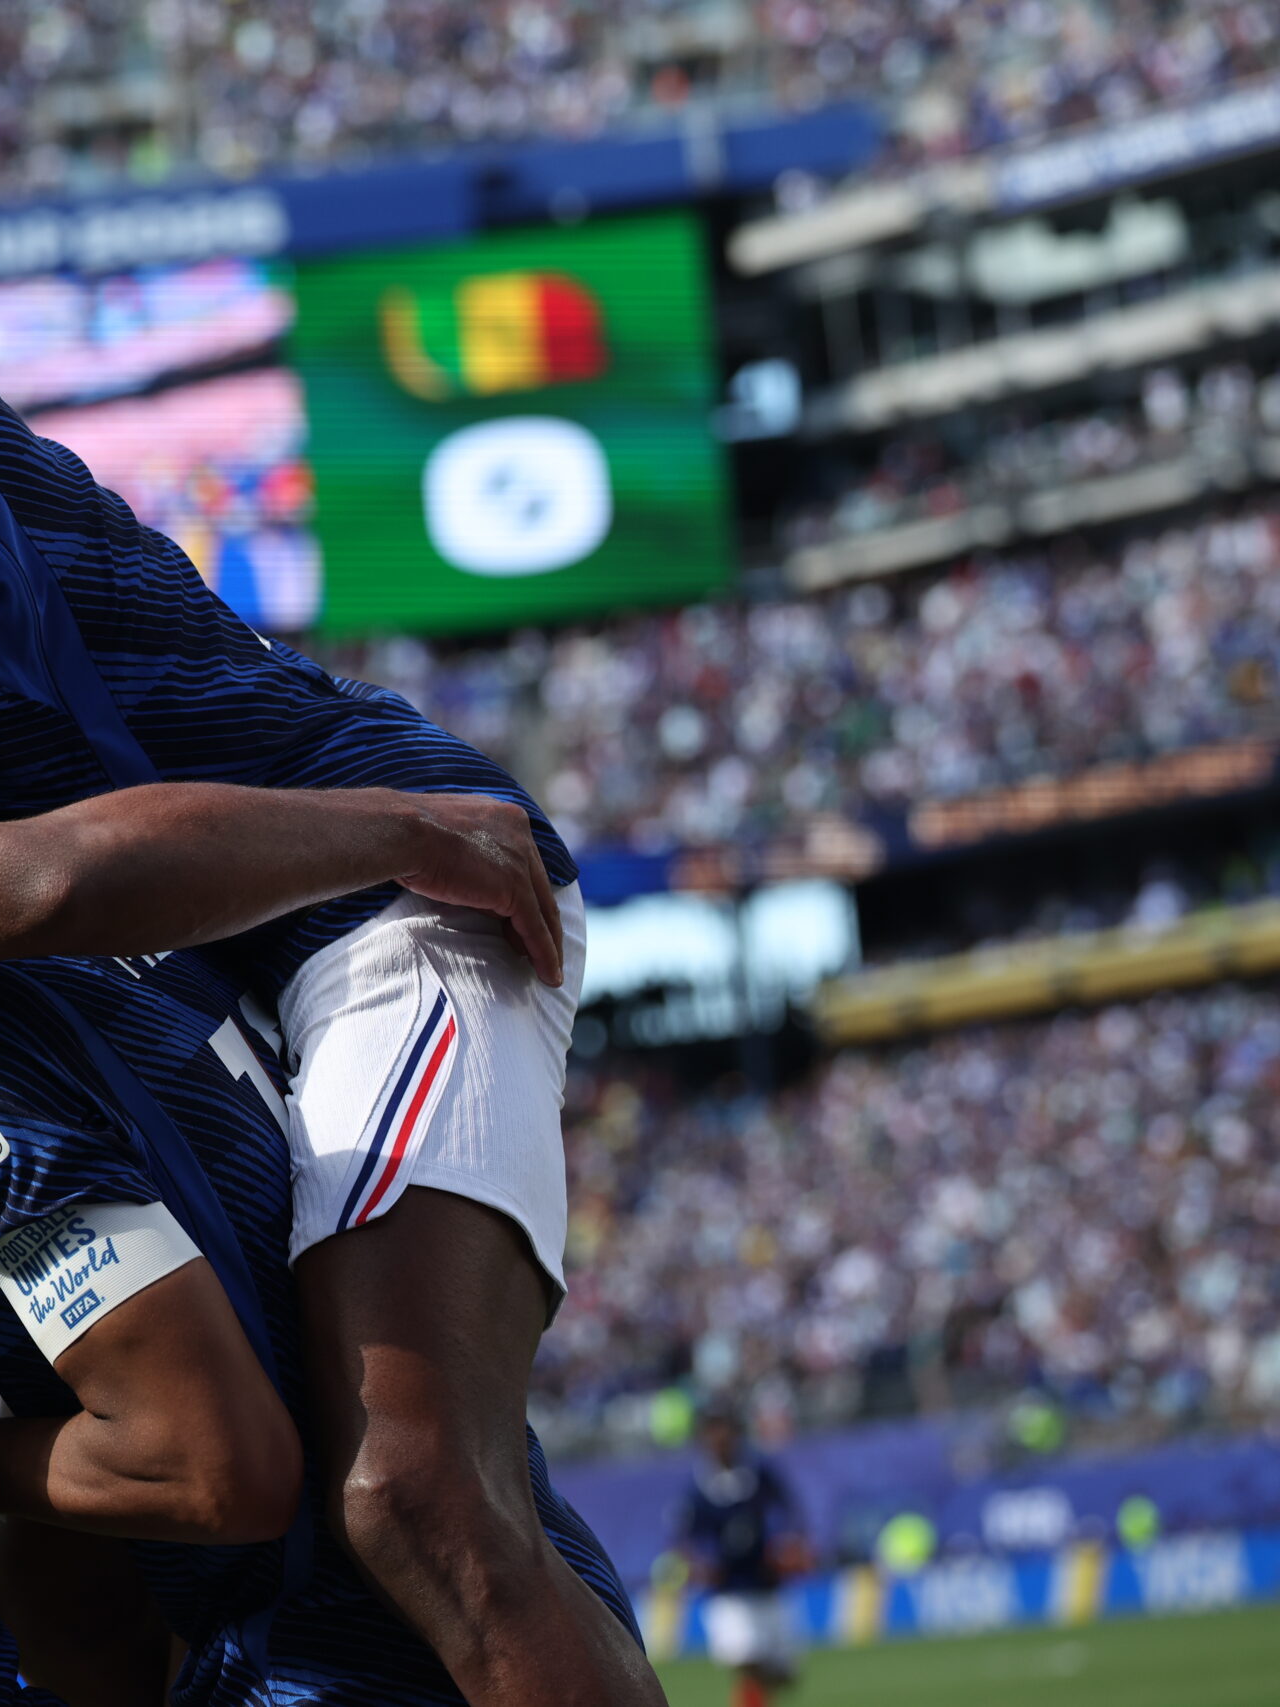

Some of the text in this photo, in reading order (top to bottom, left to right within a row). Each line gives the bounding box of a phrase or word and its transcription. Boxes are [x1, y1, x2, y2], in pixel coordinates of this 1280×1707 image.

[10, 1216, 97, 1297] UNITES
[28, 1237, 120, 1324] the World
[63, 1293, 99, 1326] FIFA
